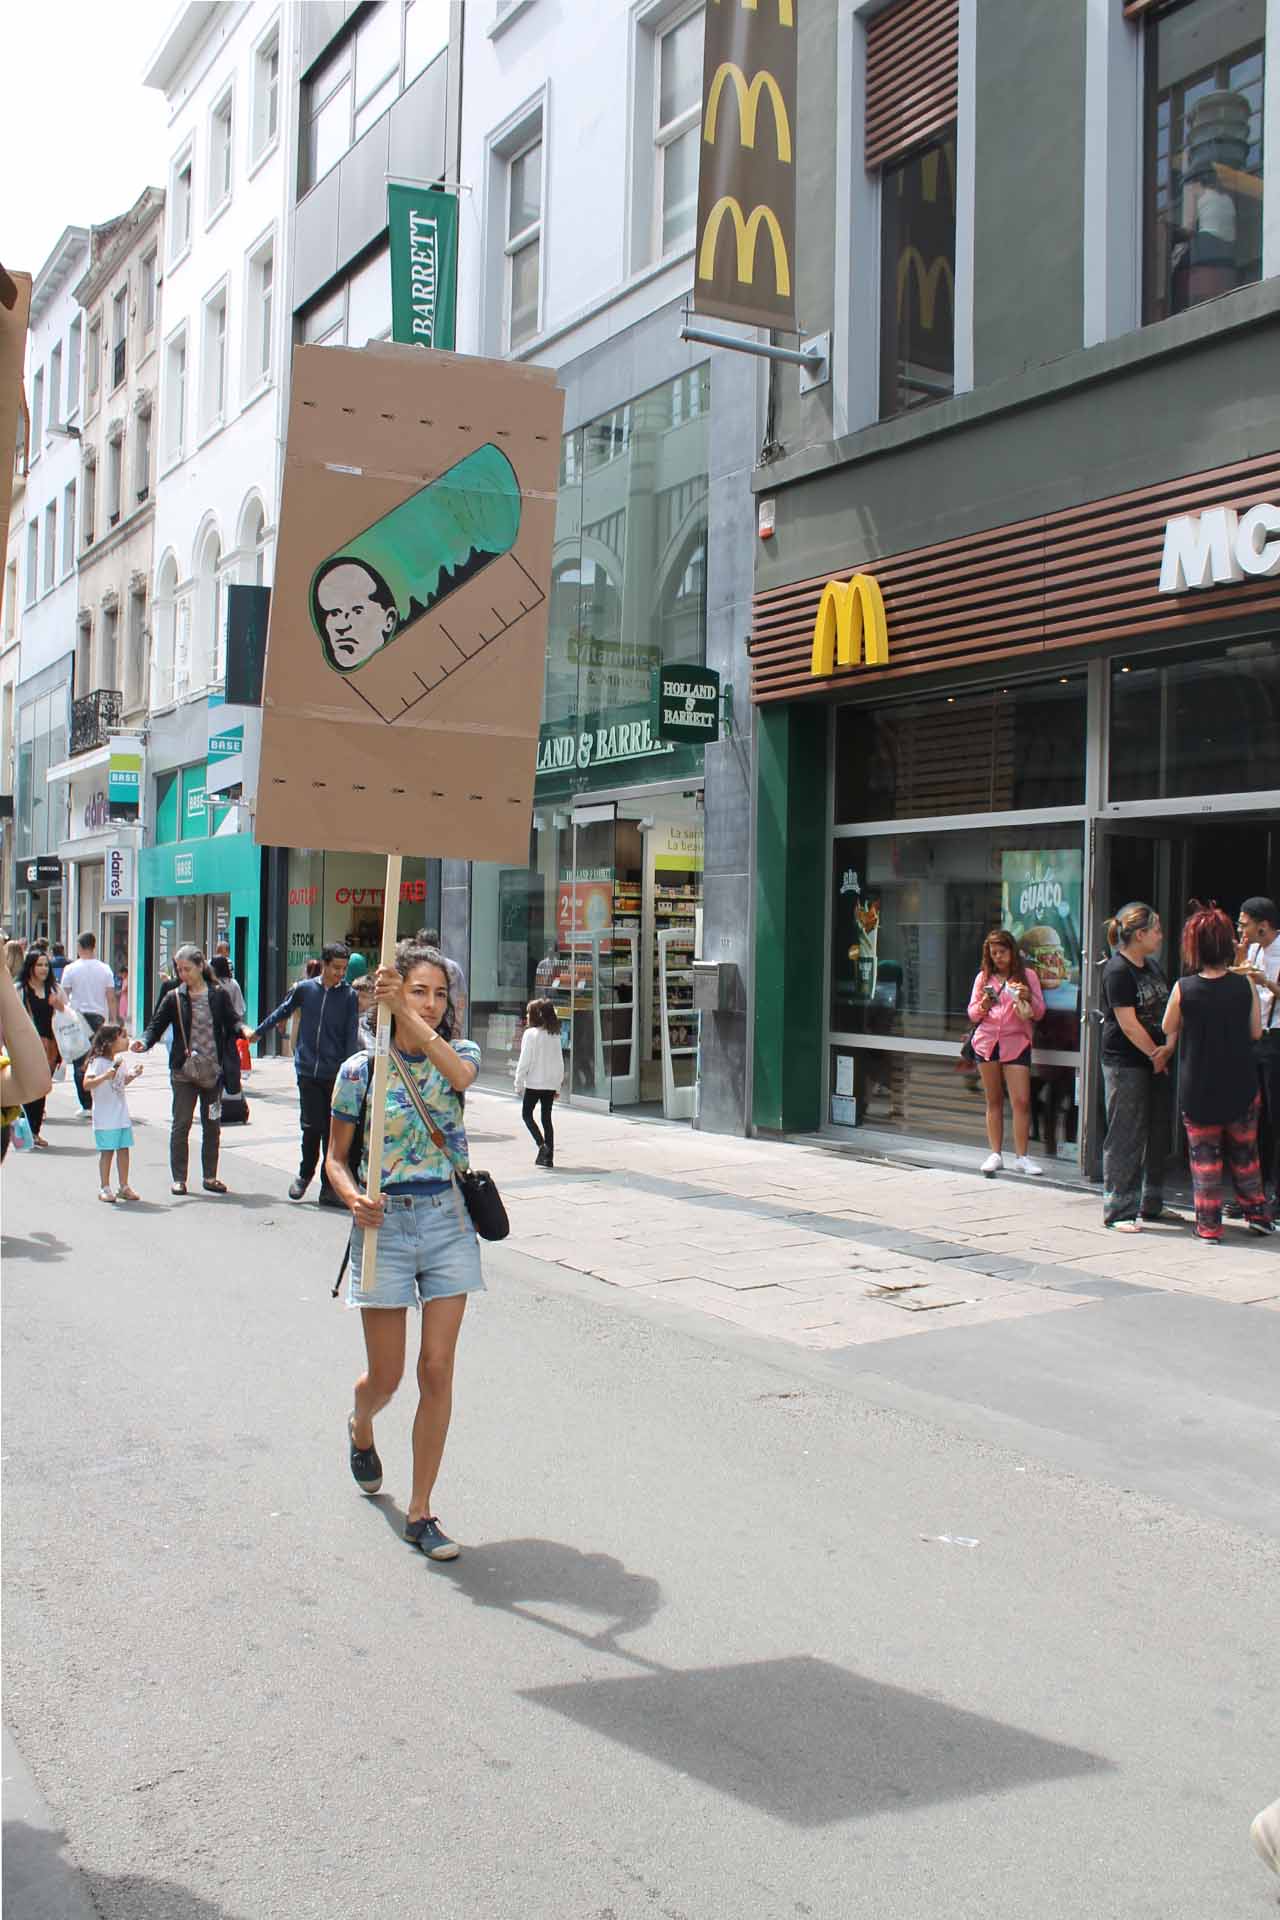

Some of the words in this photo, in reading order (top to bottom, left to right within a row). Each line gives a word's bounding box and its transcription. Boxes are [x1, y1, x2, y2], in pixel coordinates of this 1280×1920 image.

[409, 209, 438, 336] BARRETT
[663, 681, 717, 700] HOLLAND
[684, 697, 697, 711] &
[663, 709, 715, 727] BARRETT
[210, 739, 241, 752] BASE
[576, 732, 594, 769] &
[595, 719, 675, 760] BARRE
[111, 772, 138, 783] BASE
[111, 851, 124, 897] claire's
[1020, 883, 1062, 915] GUACO
[291, 932, 315, 947] STOCK
